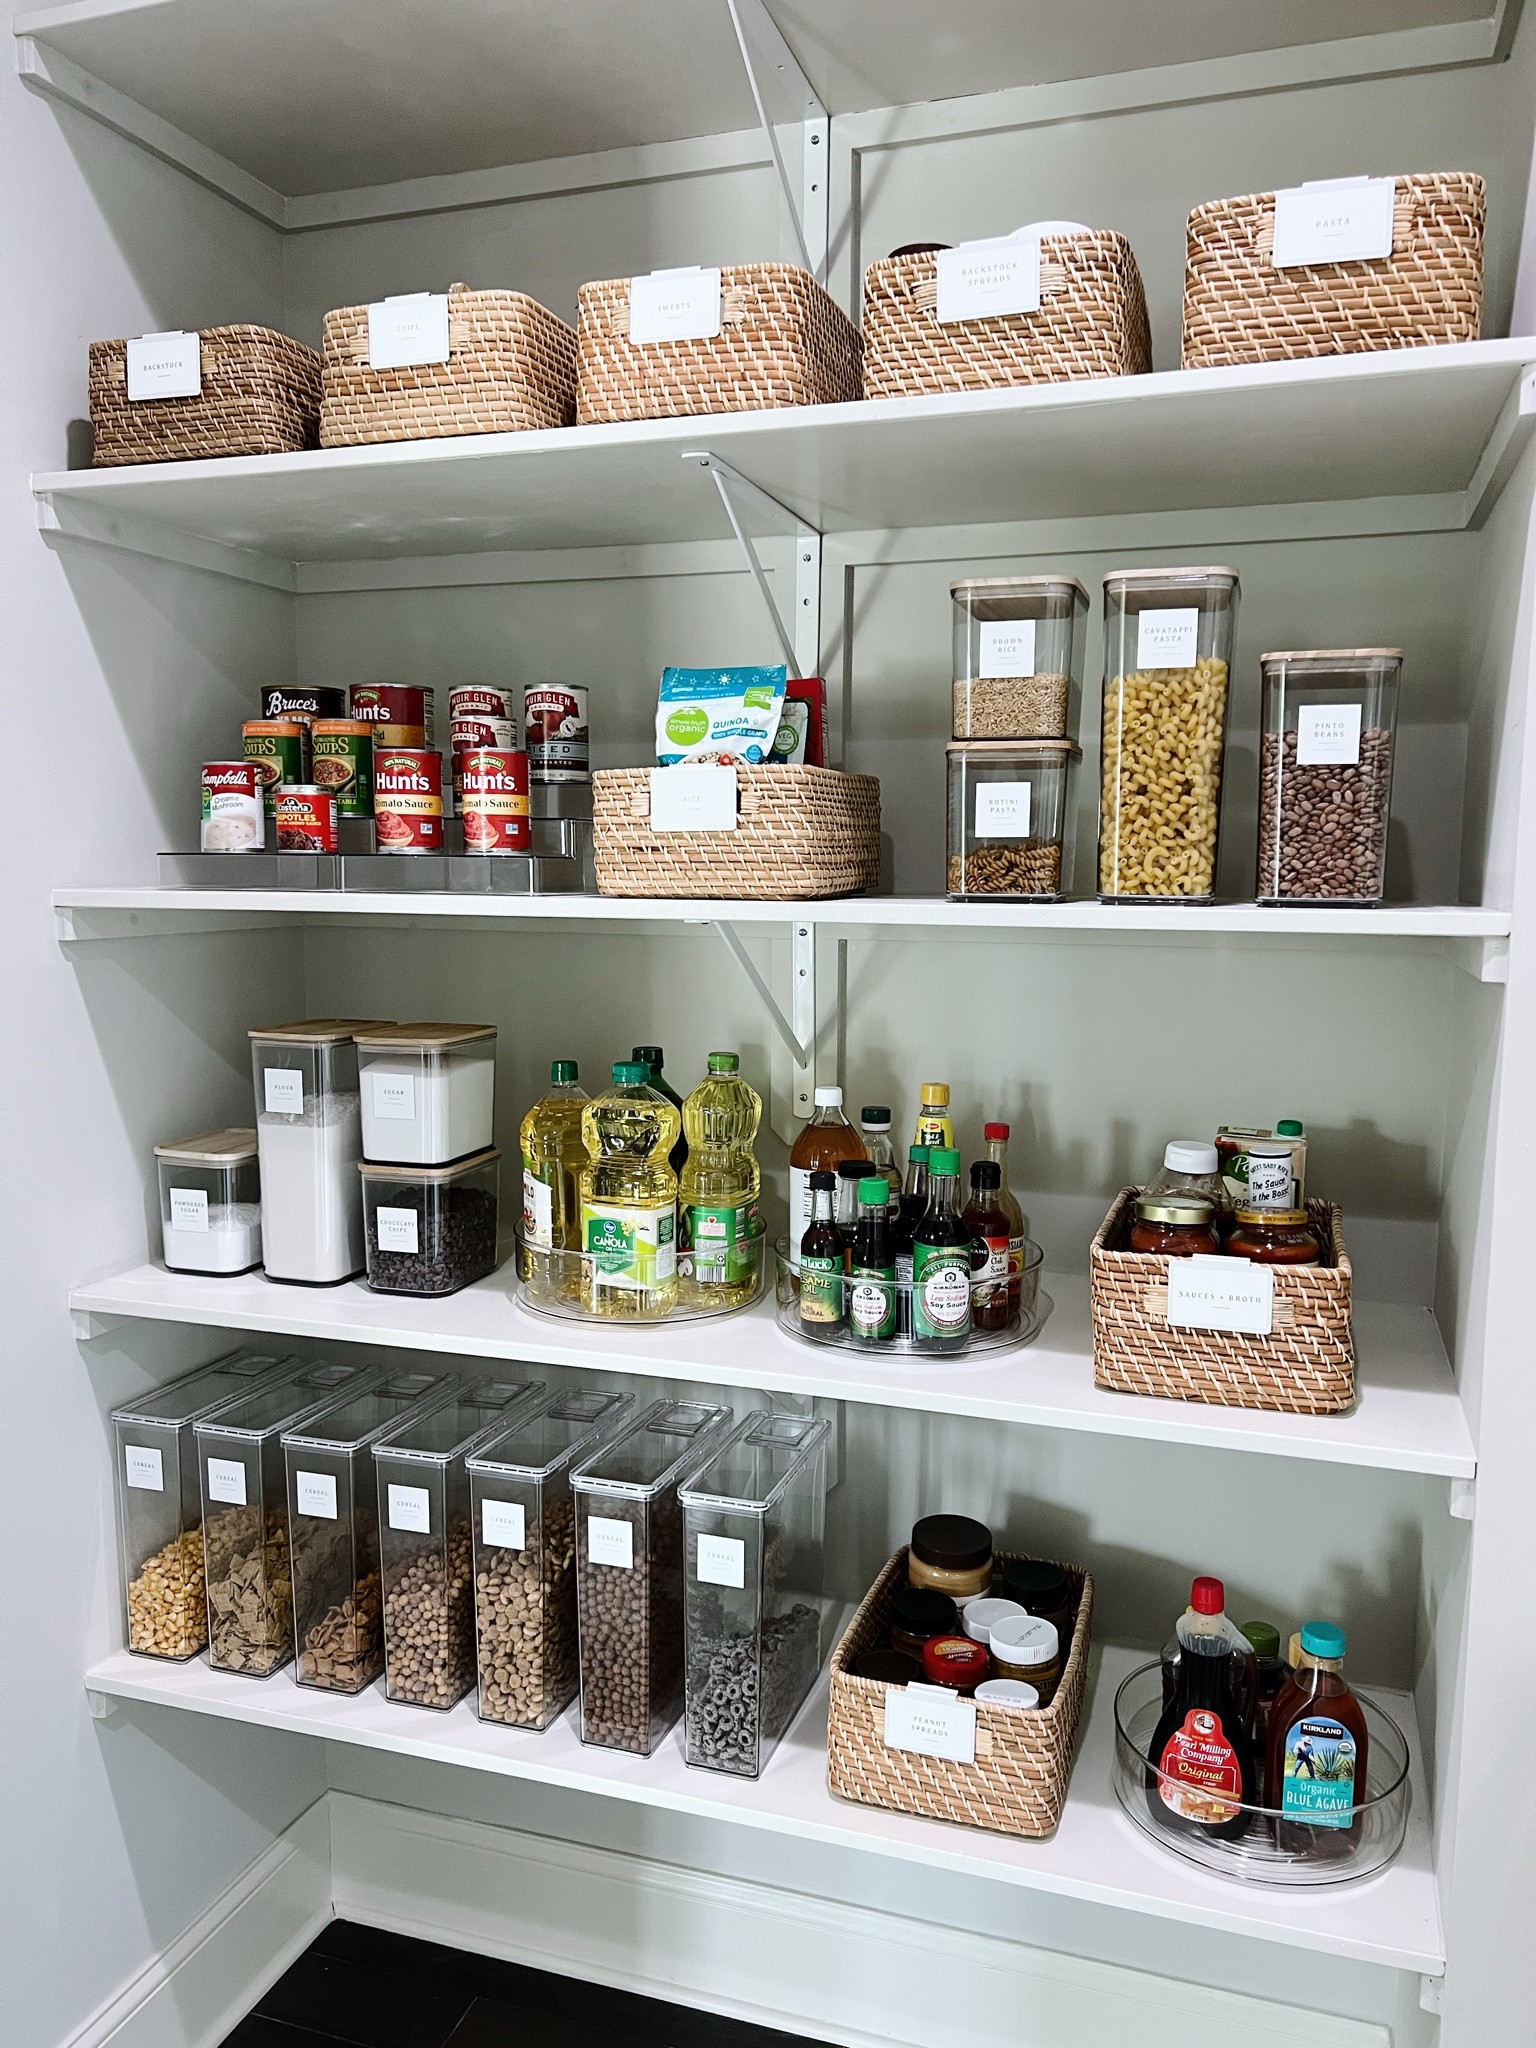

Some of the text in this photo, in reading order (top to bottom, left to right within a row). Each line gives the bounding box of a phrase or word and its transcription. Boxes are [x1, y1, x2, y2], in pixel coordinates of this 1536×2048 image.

[1316, 218, 1350, 229] PASTA
[961, 261, 1018, 276] BACKSTOCK
[967, 274, 1011, 287] SPREADS
[657, 302, 691, 313] SWEETS
[397, 323, 420, 333] CHIPS
[143, 361, 183, 372] BACKSTOCK
[1144, 626, 1192, 635] CAVATAPPI
[992, 637, 1023, 645] BROWN
[266, 691, 320, 717] Bruce's
[451, 693, 498, 706] MUIR GLEN
[525, 693, 571, 707] MUIR GLEN
[690, 718, 706, 726] truth
[713, 717, 749, 729] QUINOA
[1315, 722, 1344, 730] PINTO
[462, 723, 487, 736] GLEN
[668, 724, 706, 734] organic
[713, 731, 726, 739] 100%
[778, 732, 792, 740] VEG
[394, 758, 417, 769] NATURAL
[404, 798, 433, 809] Sauce
[489, 799, 519, 809] Sauce
[683, 795, 701, 803] RICE
[212, 802, 244, 811] Mushroom
[1252, 1177, 1286, 1190] The Sauce
[1258, 1192, 1270, 1201] the
[174, 1201, 205, 1209] POWDERED
[180, 1206, 200, 1214] SUGAR
[380, 1219, 415, 1229] CHOCOLATE
[388, 1226, 407, 1234] CHIPS
[593, 1235, 628, 1249] CANOLA
[808, 1258, 828, 1270] Luck
[990, 1265, 1006, 1274] Sauce
[803, 1285, 818, 1294] OIL
[930, 1294, 967, 1302] Less Sodium
[1179, 1291, 1215, 1300] SAUCES
[1229, 1294, 1262, 1304] BROTH
[930, 1301, 967, 1310] Soy Sauce
[133, 1461, 155, 1470] CEREAL
[216, 1474, 237, 1483] CEREAL
[304, 1488, 329, 1497] CEREAL
[396, 1500, 422, 1510] CEREAL
[491, 1516, 516, 1525] CEREAL
[597, 1533, 624, 1543] CEREAL
[707, 1552, 735, 1562] CEREAL
[913, 1715, 947, 1727] PEANUT
[910, 1724, 949, 1737] SPREADS
[1302, 1723, 1342, 1735] KIRKLAND
[1174, 1732, 1232, 1758] Pearl Milling
[1180, 1747, 1224, 1765] Company
[1178, 1762, 1224, 1781] Original
[1300, 1781, 1337, 1797] Organic
[1286, 1790, 1349, 1811] BLUE AGAVE
